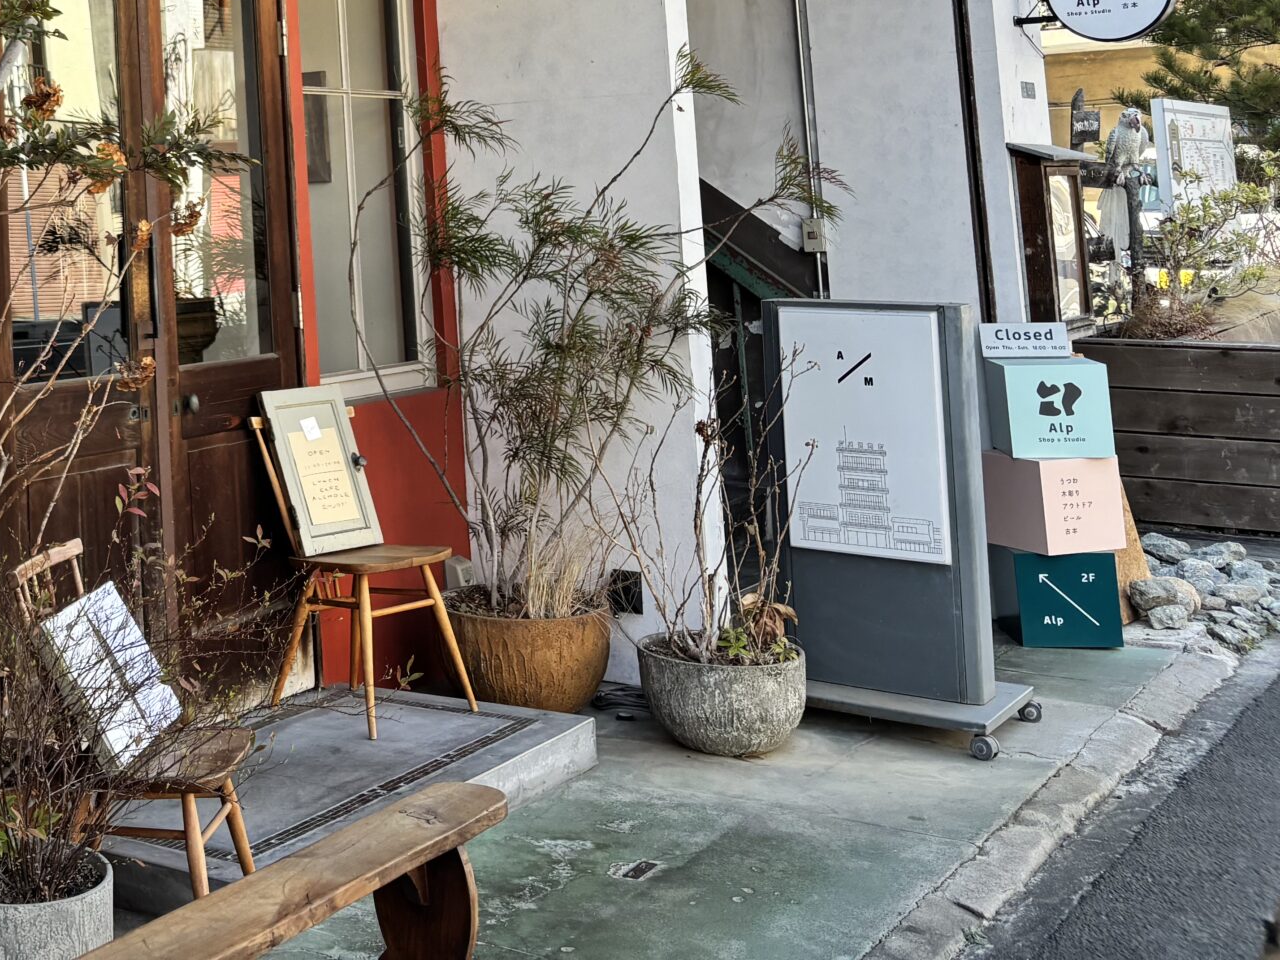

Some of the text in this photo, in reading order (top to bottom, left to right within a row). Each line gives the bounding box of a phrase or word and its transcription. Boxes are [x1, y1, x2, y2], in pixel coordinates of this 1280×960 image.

[1121, 1, 1139, 10] 古本
[994, 328, 1054, 341] Closed
[836, 350, 844, 360] A
[864, 376, 874, 387] M
[1049, 422, 1074, 435] Alp
[1062, 500, 1093, 510] アウトドア
[1081, 573, 1095, 583] 2F
[1043, 615, 1064, 627] Alp
